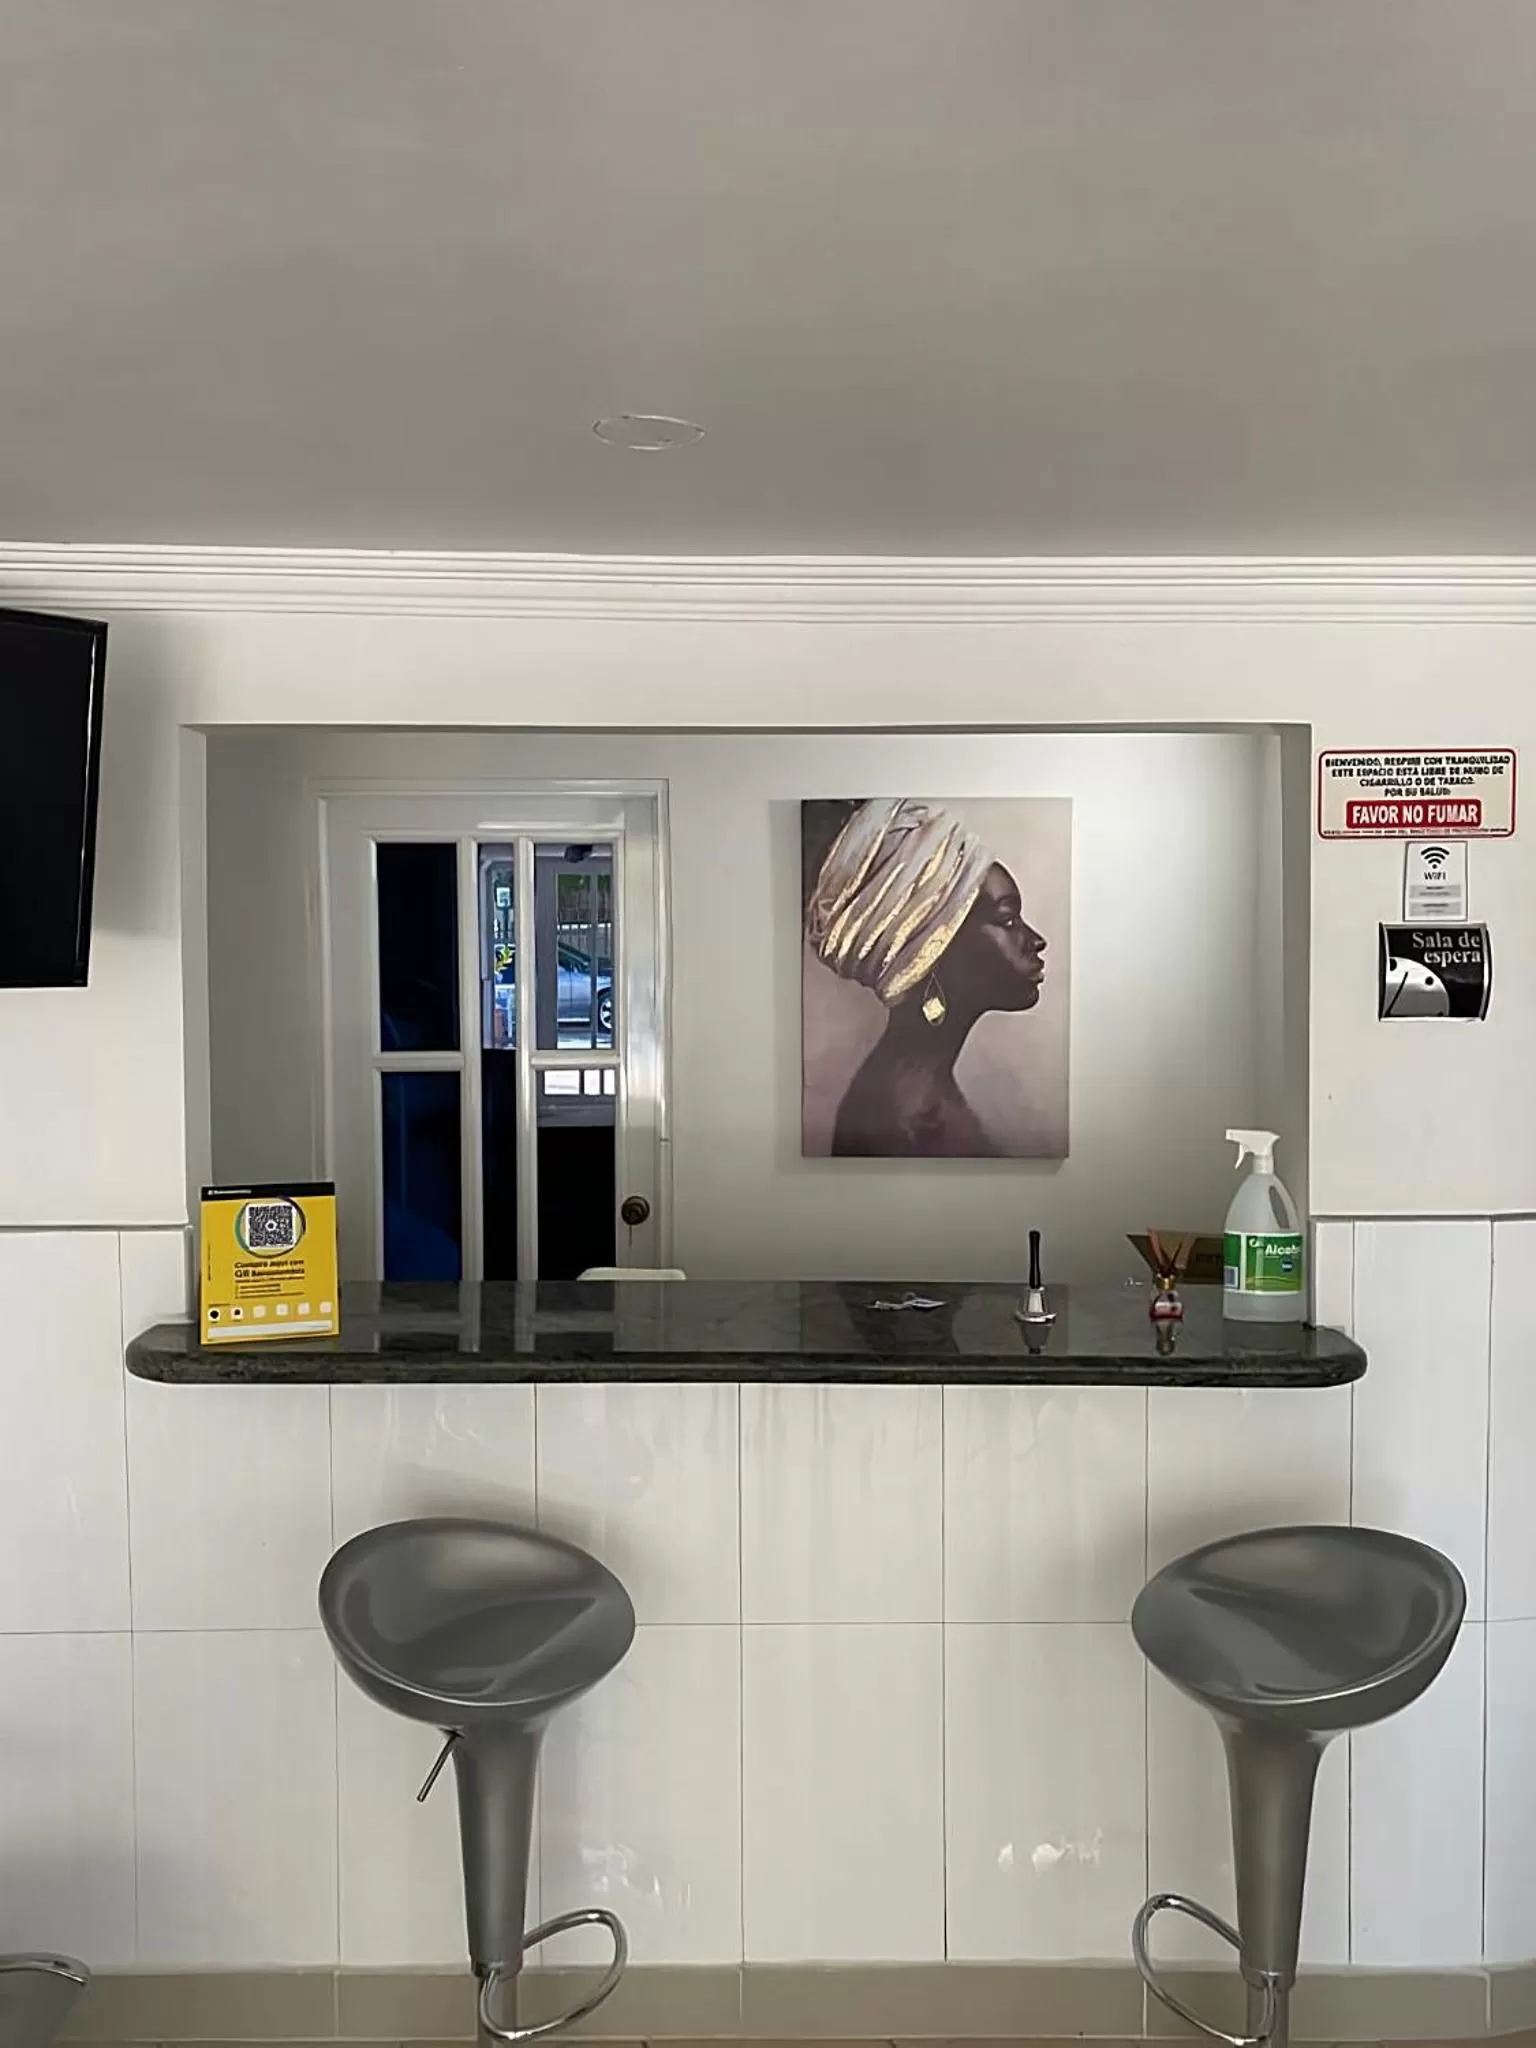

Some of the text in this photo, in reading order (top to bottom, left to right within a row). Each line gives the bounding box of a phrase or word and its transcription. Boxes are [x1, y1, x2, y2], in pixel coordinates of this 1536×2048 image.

[1424, 757, 1443, 765] CON
[1445, 756, 1511, 765] TRANQUILIDAD
[1332, 768, 1354, 777] ESTE
[1356, 768, 1394, 776] ESPACIO
[1421, 767, 1446, 776] LIBRE
[1449, 767, 1460, 775] DE
[1492, 766, 1504, 775] DE
[1360, 778, 1413, 787] CIGARRILLO
[1415, 778, 1422, 786] O
[1424, 777, 1436, 786] DE
[1384, 788, 1403, 797] POR
[1405, 787, 1418, 796] SU
[1352, 804, 1478, 824] FAVOR NO FUMAR
[1412, 931, 1481, 949] Sala de
[1424, 950, 1482, 968] espera
